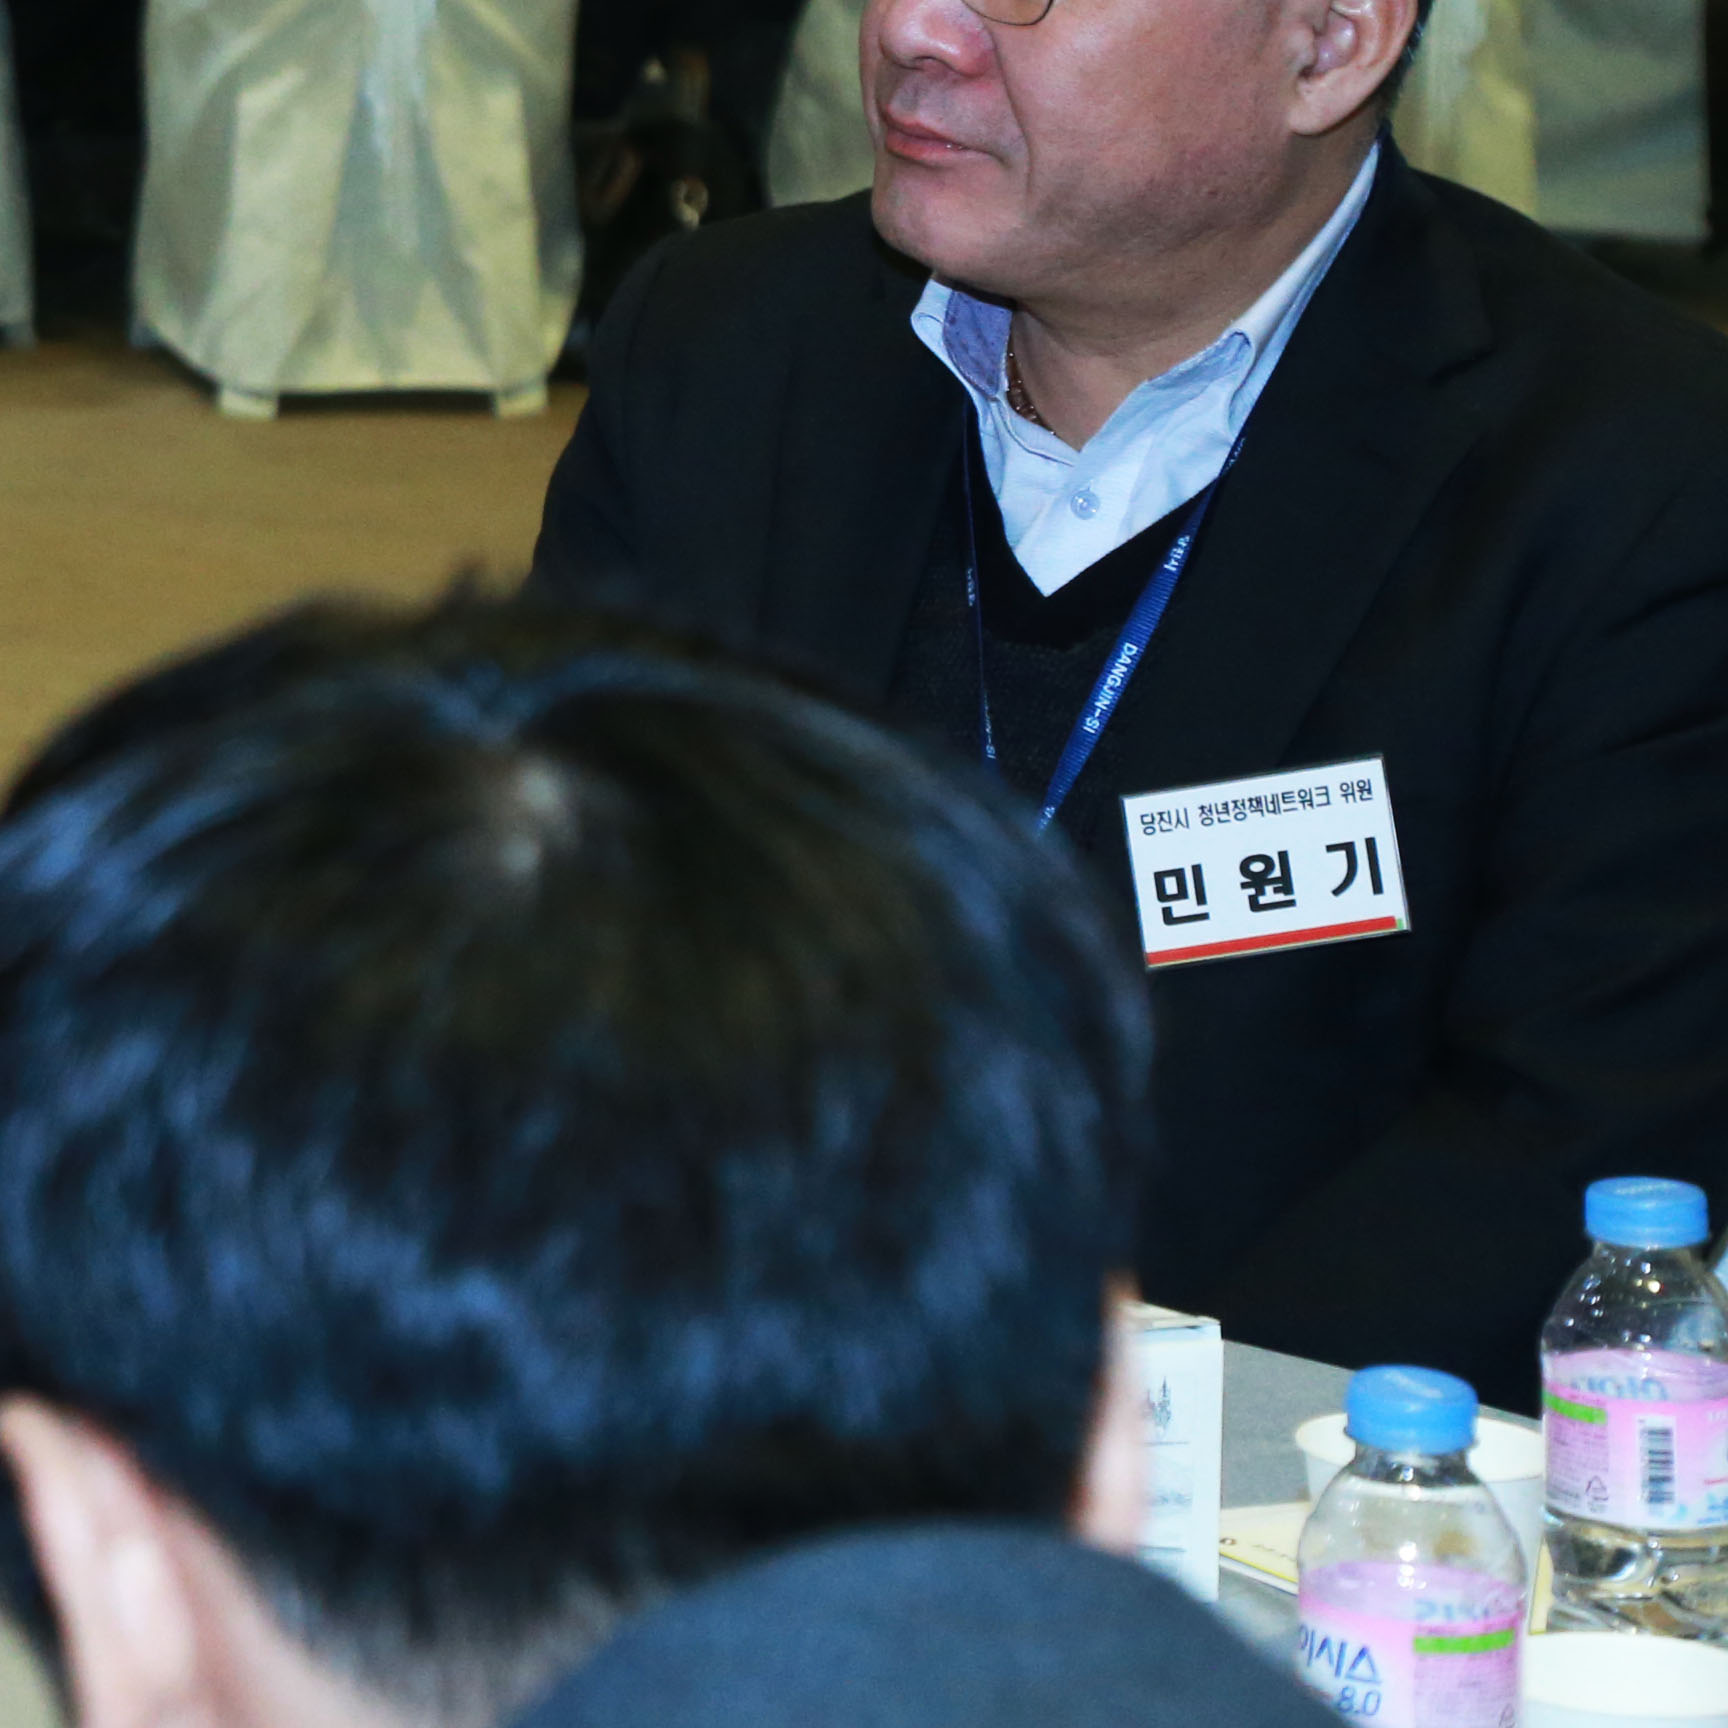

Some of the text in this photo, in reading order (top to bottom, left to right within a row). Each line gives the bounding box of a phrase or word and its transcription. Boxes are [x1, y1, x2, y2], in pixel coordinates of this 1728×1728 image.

[1082, 641, 1139, 735] DANGJIN-SI
[1140, 778, 1375, 836] 당진시 청년정책네트워크 위원
[1337, 1685, 1382, 1717] 8.0
